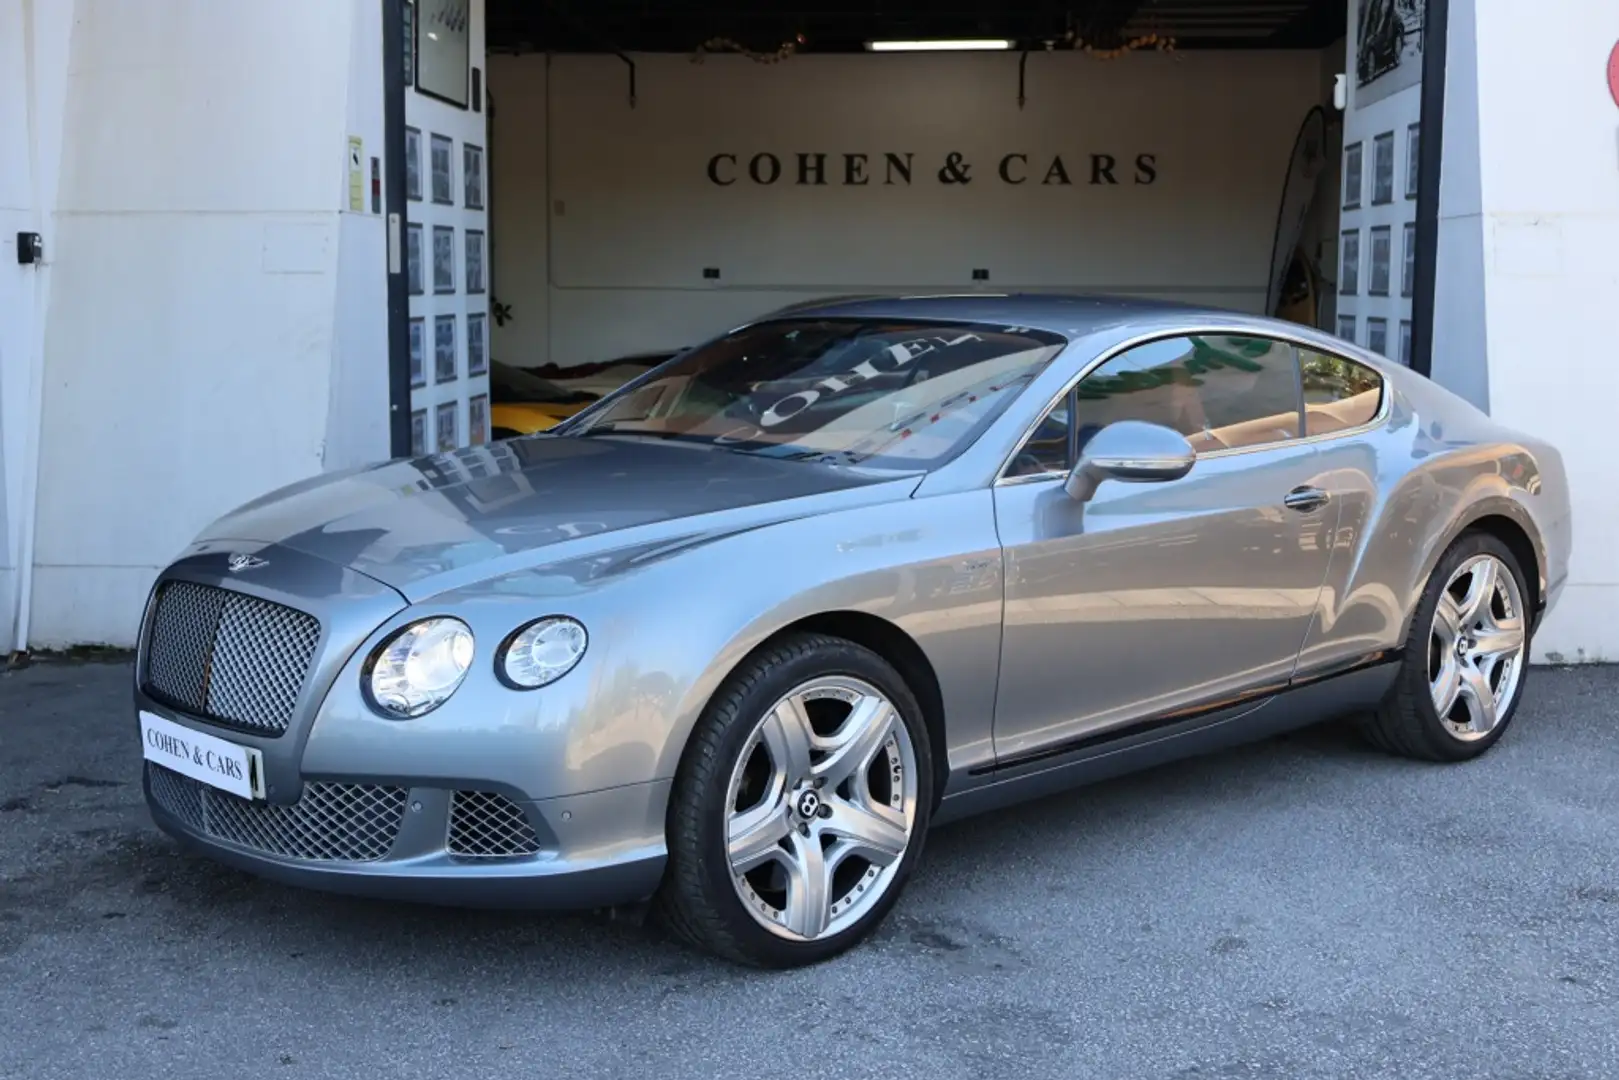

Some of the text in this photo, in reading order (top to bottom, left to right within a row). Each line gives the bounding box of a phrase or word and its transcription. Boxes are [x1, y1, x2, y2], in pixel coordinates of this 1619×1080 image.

[706, 152, 1158, 186] COHEN & CARS
[147, 728, 190, 760] COHEN
[193, 745, 203, 767] &
[206, 750, 243, 781] CARS
